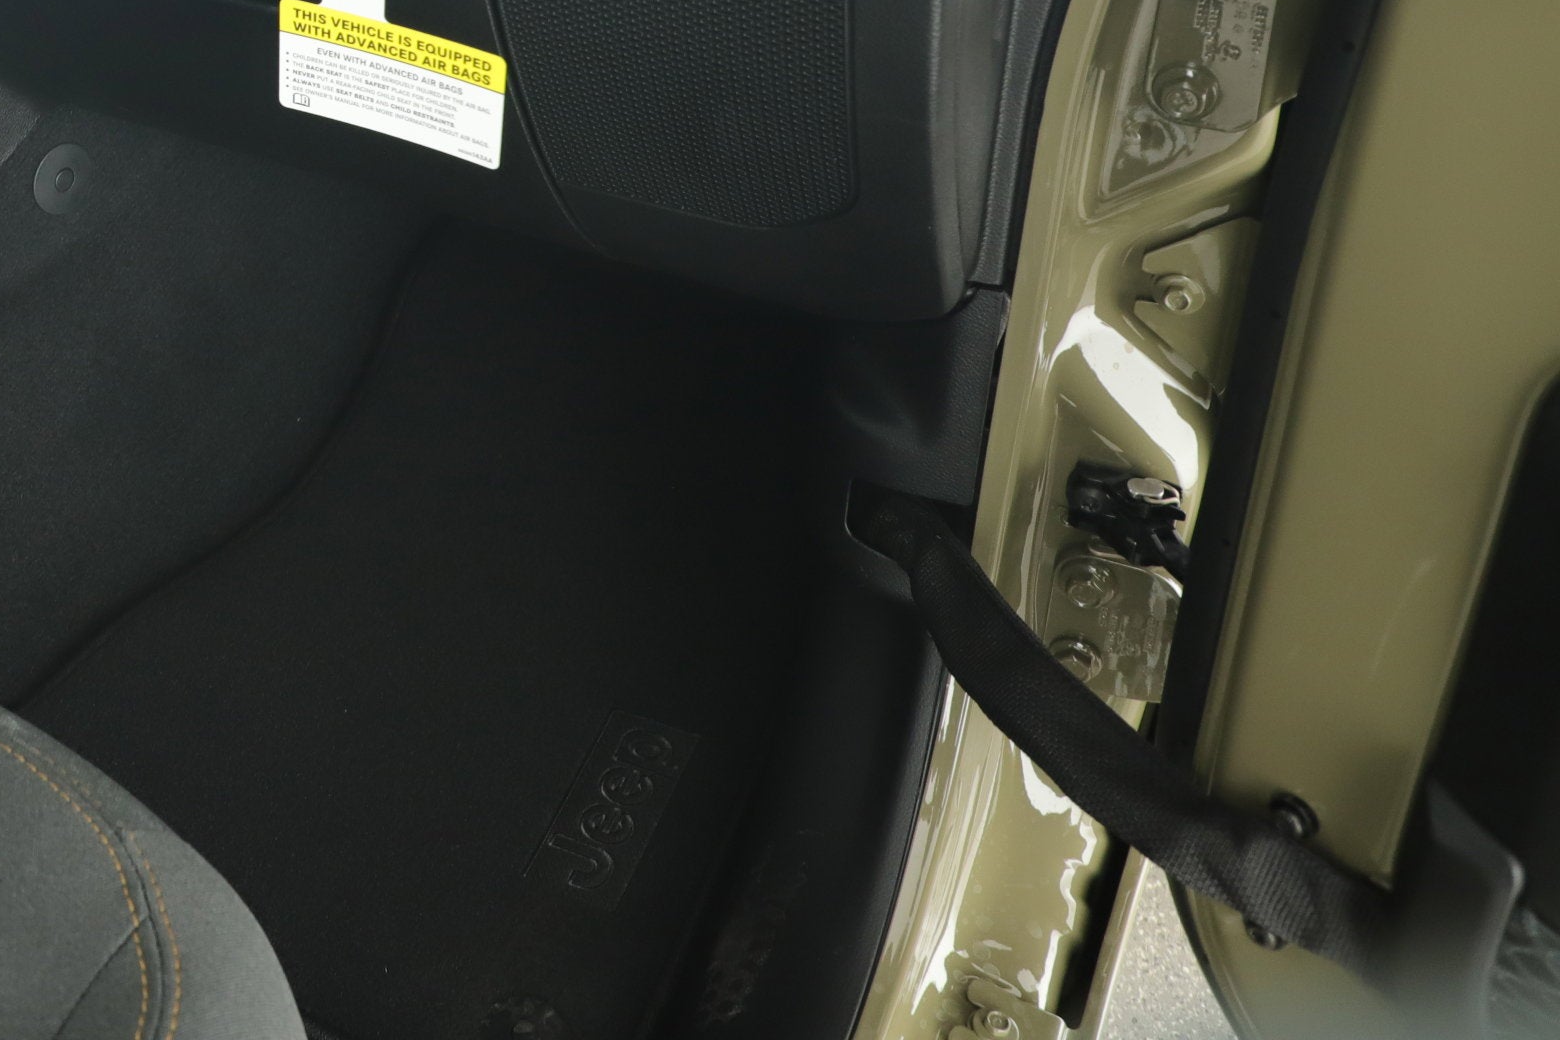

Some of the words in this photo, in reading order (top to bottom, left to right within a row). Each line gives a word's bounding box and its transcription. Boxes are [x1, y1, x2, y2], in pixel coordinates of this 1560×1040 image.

[293, 6, 326, 25] THIS
[331, 16, 393, 43] VEHICLE
[398, 34, 411, 47] IS
[417, 40, 491, 72] EQUIPPED
[293, 19, 330, 40] WITH
[335, 29, 417, 63] ADVANCED
[421, 54, 446, 71] AIR
[451, 63, 490, 85] BAGS
[317, 46, 340, 60] EVEN
[343, 53, 366, 66] WITH
[369, 60, 418, 81] ADVANCED
[421, 75, 435, 86] AIR
[438, 81, 463, 95] BAGS
[548, 727, 679, 891] Jeep
